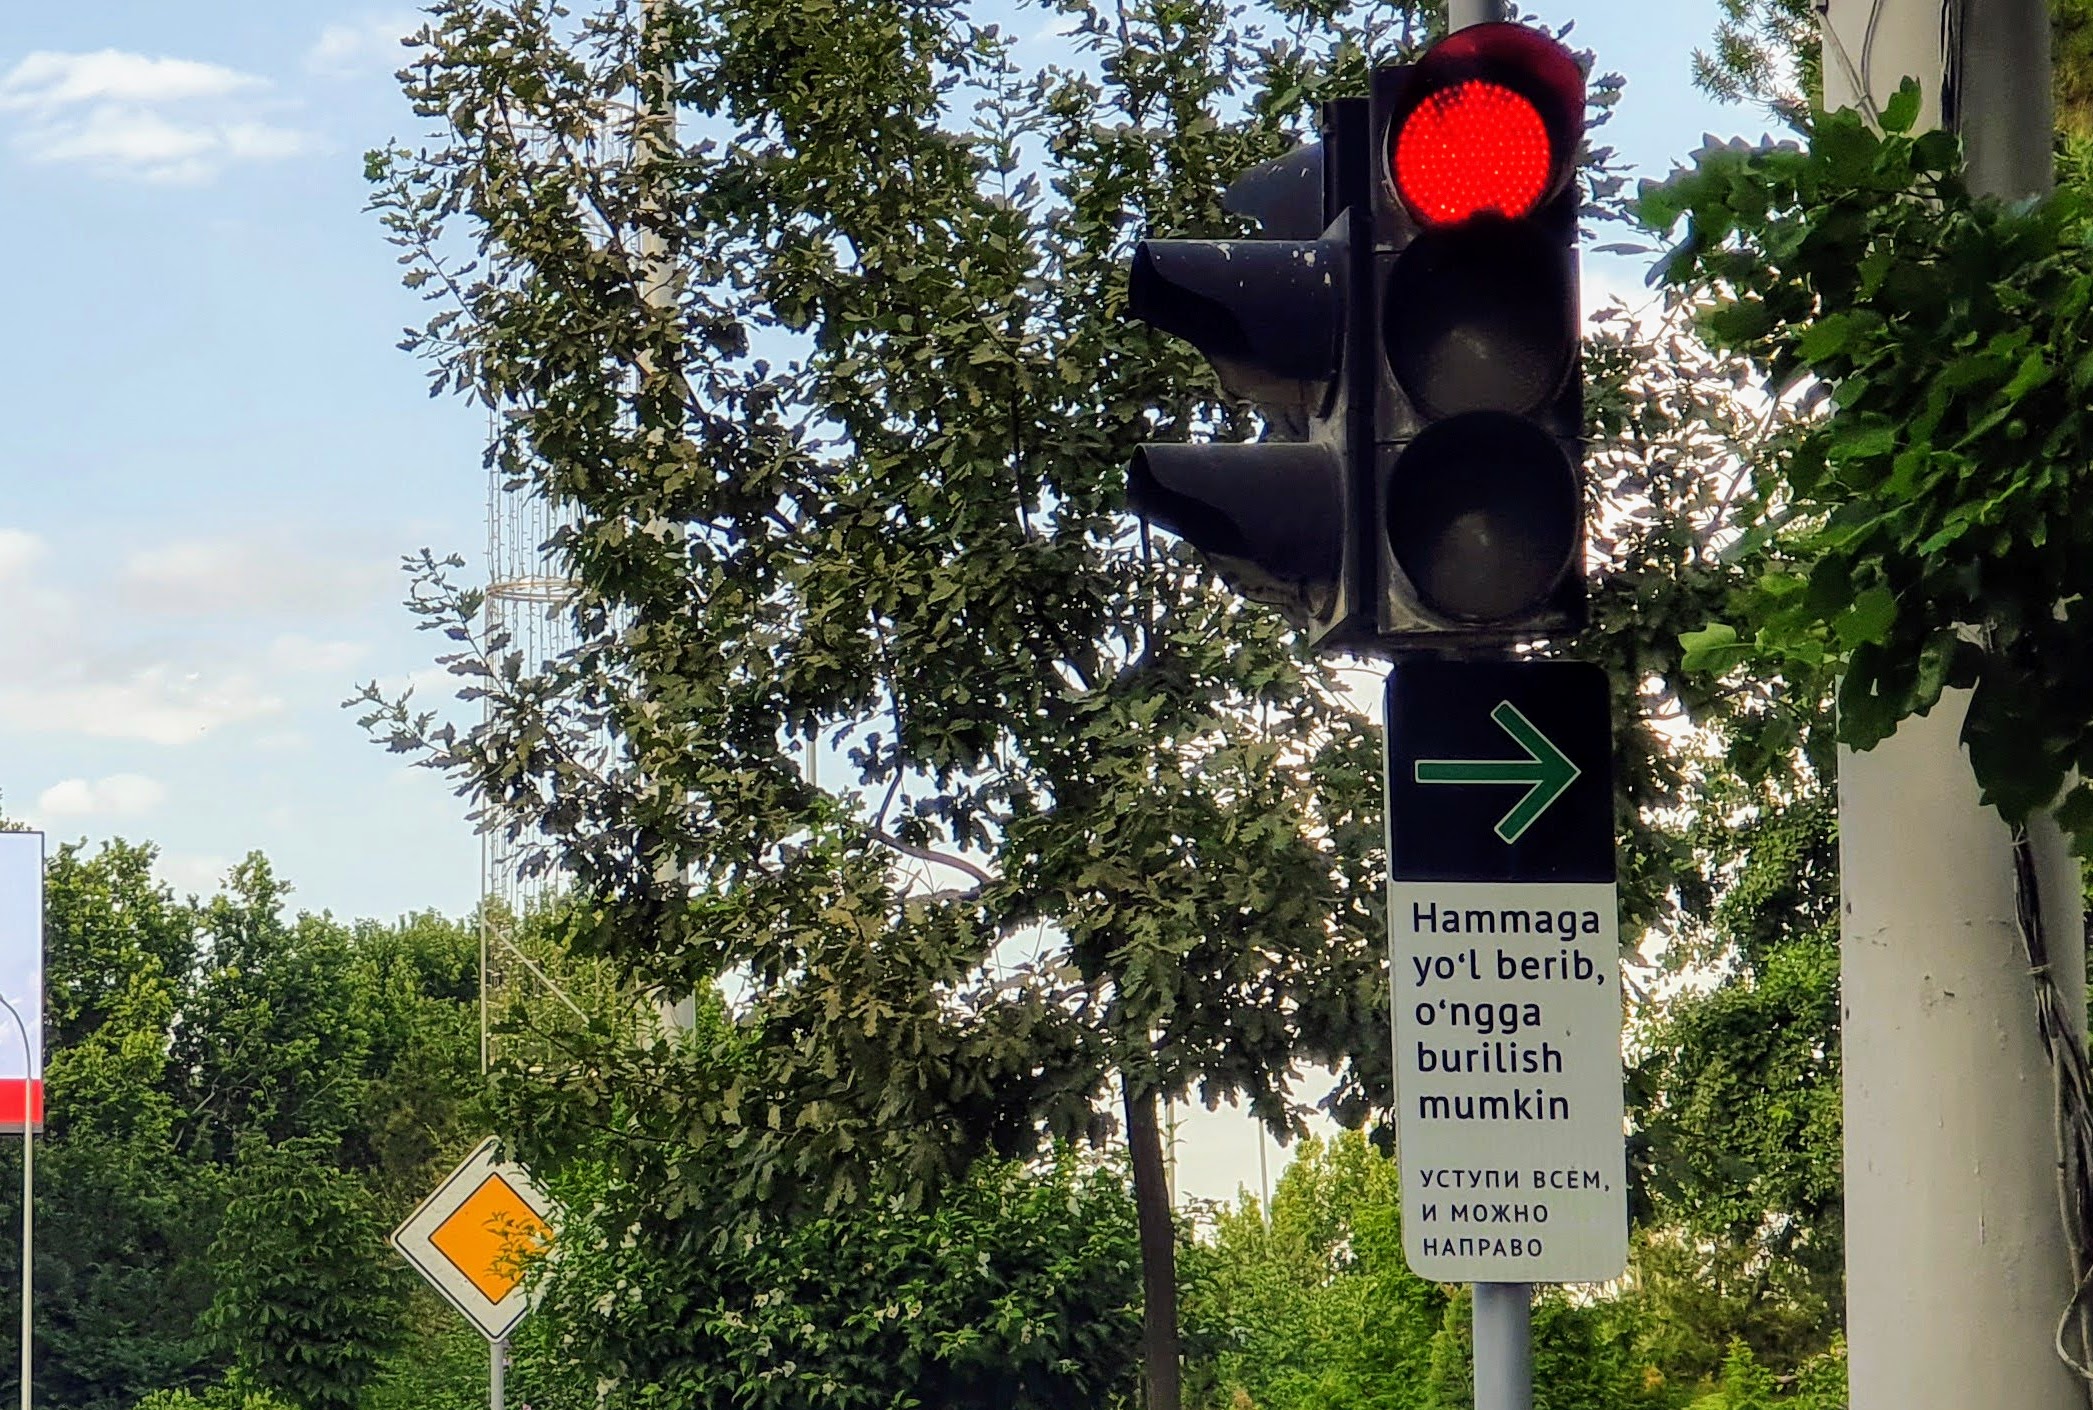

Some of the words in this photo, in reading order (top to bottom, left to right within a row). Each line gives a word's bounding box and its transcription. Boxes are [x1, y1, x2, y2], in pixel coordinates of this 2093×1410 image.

[1412, 902, 1600, 942] Hammaga
[1497, 949, 1605, 986] berib,
[1417, 1041, 1563, 1073] burilish
[1419, 1088, 1569, 1120] mumkin
[1419, 1169, 1520, 1189] УСТУПИ
[1533, 1170, 1611, 1192] ВСЕМ,
[1422, 1203, 1437, 1222] И
[1451, 1204, 1549, 1223] МОЖНО
[1423, 1238, 1543, 1257] НАПРАВО
